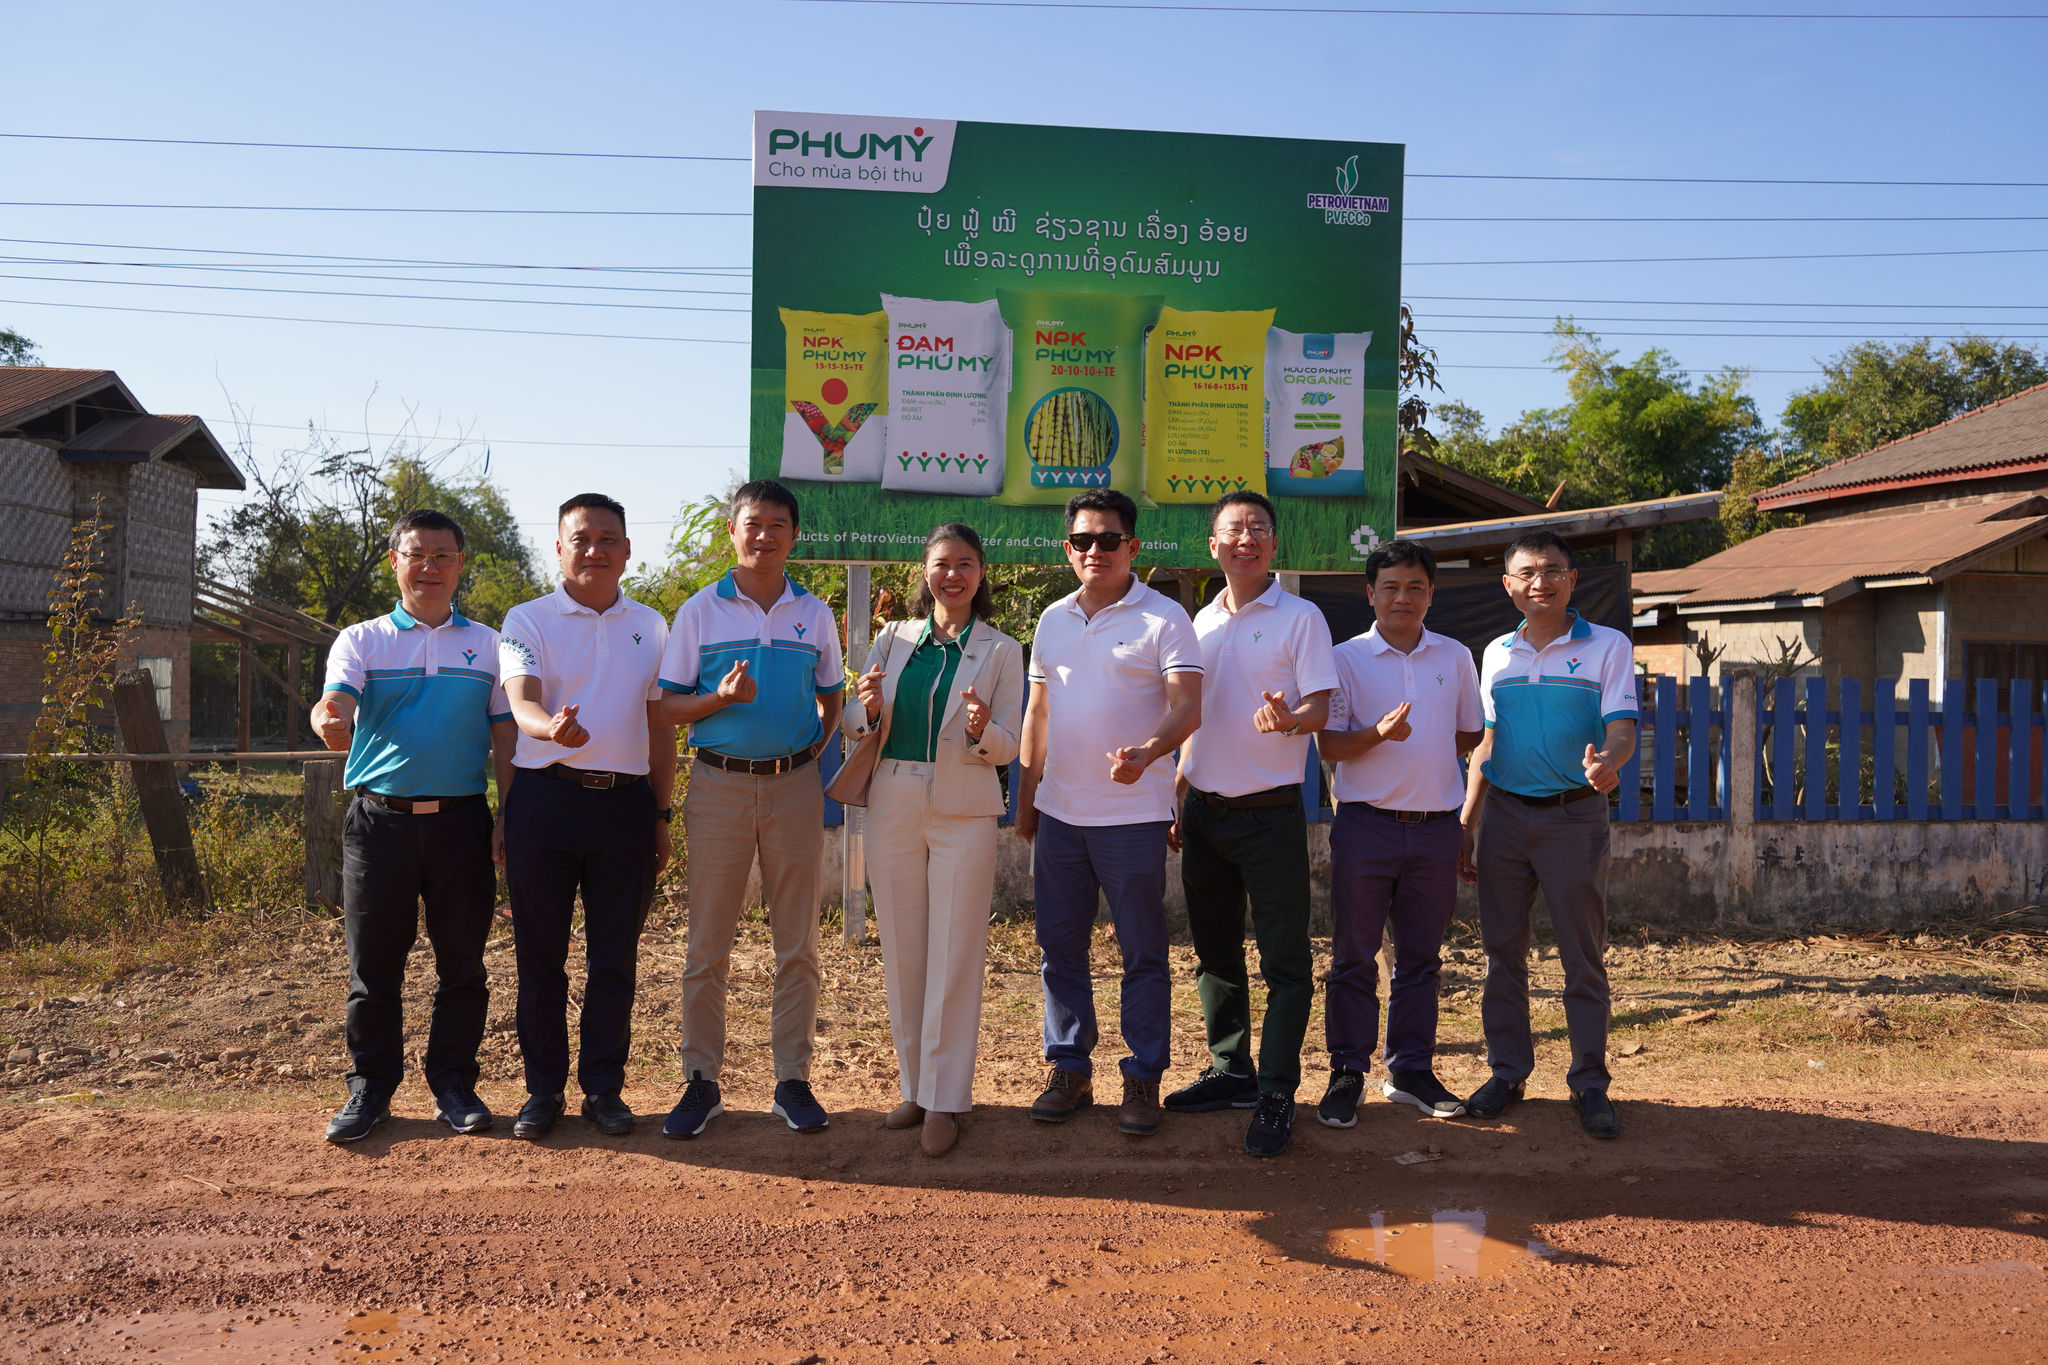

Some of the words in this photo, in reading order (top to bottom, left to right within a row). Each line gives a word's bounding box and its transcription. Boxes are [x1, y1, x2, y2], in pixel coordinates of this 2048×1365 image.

[768, 161, 806, 178] Cho
[812, 163, 851, 180] mùa
[858, 165, 887, 184] bội
[893, 167, 923, 183] thu
[1308, 193, 1389, 212] PETROVIETNAM
[1325, 209, 1371, 226] PVFCCo
[1199, 218, 1248, 243] ອ້ອຍ
[802, 335, 844, 349] NPK
[896, 335, 954, 352] ĐẠM
[1035, 330, 1087, 347] NPK
[802, 349, 840, 361] PHÚ
[1035, 348, 1082, 363] PHÚ
[1165, 343, 1223, 362] NPK
[815, 362, 864, 371] 15-15-15+TE
[897, 353, 953, 371] PHÚ
[1051, 364, 1116, 377] 20-10-10+TE
[1164, 364, 1216, 379] PHÚ
[1283, 374, 1353, 386] ORGANIC
[795, 530, 830, 542] ducts
[833, 531, 847, 542] of
[851, 532, 929, 545] PetroVietna
[1006, 536, 1030, 548] and
